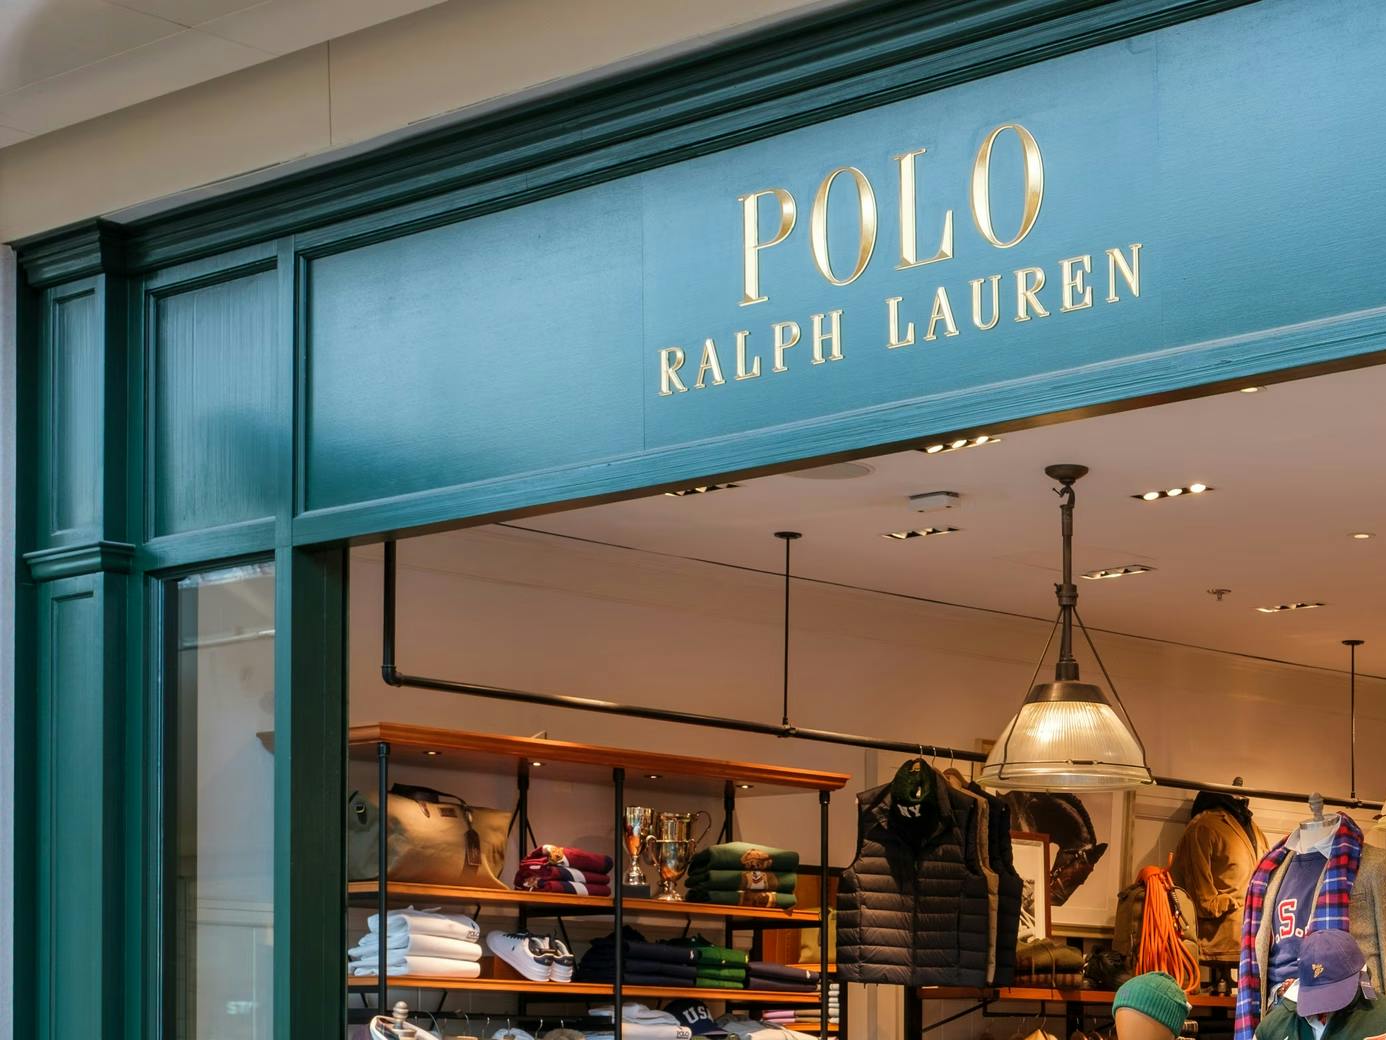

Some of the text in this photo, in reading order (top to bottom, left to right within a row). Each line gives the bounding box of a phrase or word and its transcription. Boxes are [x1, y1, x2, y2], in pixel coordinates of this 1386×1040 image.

[737, 123, 1044, 307] POLO
[657, 243, 1143, 397] RALPH LAUREN
